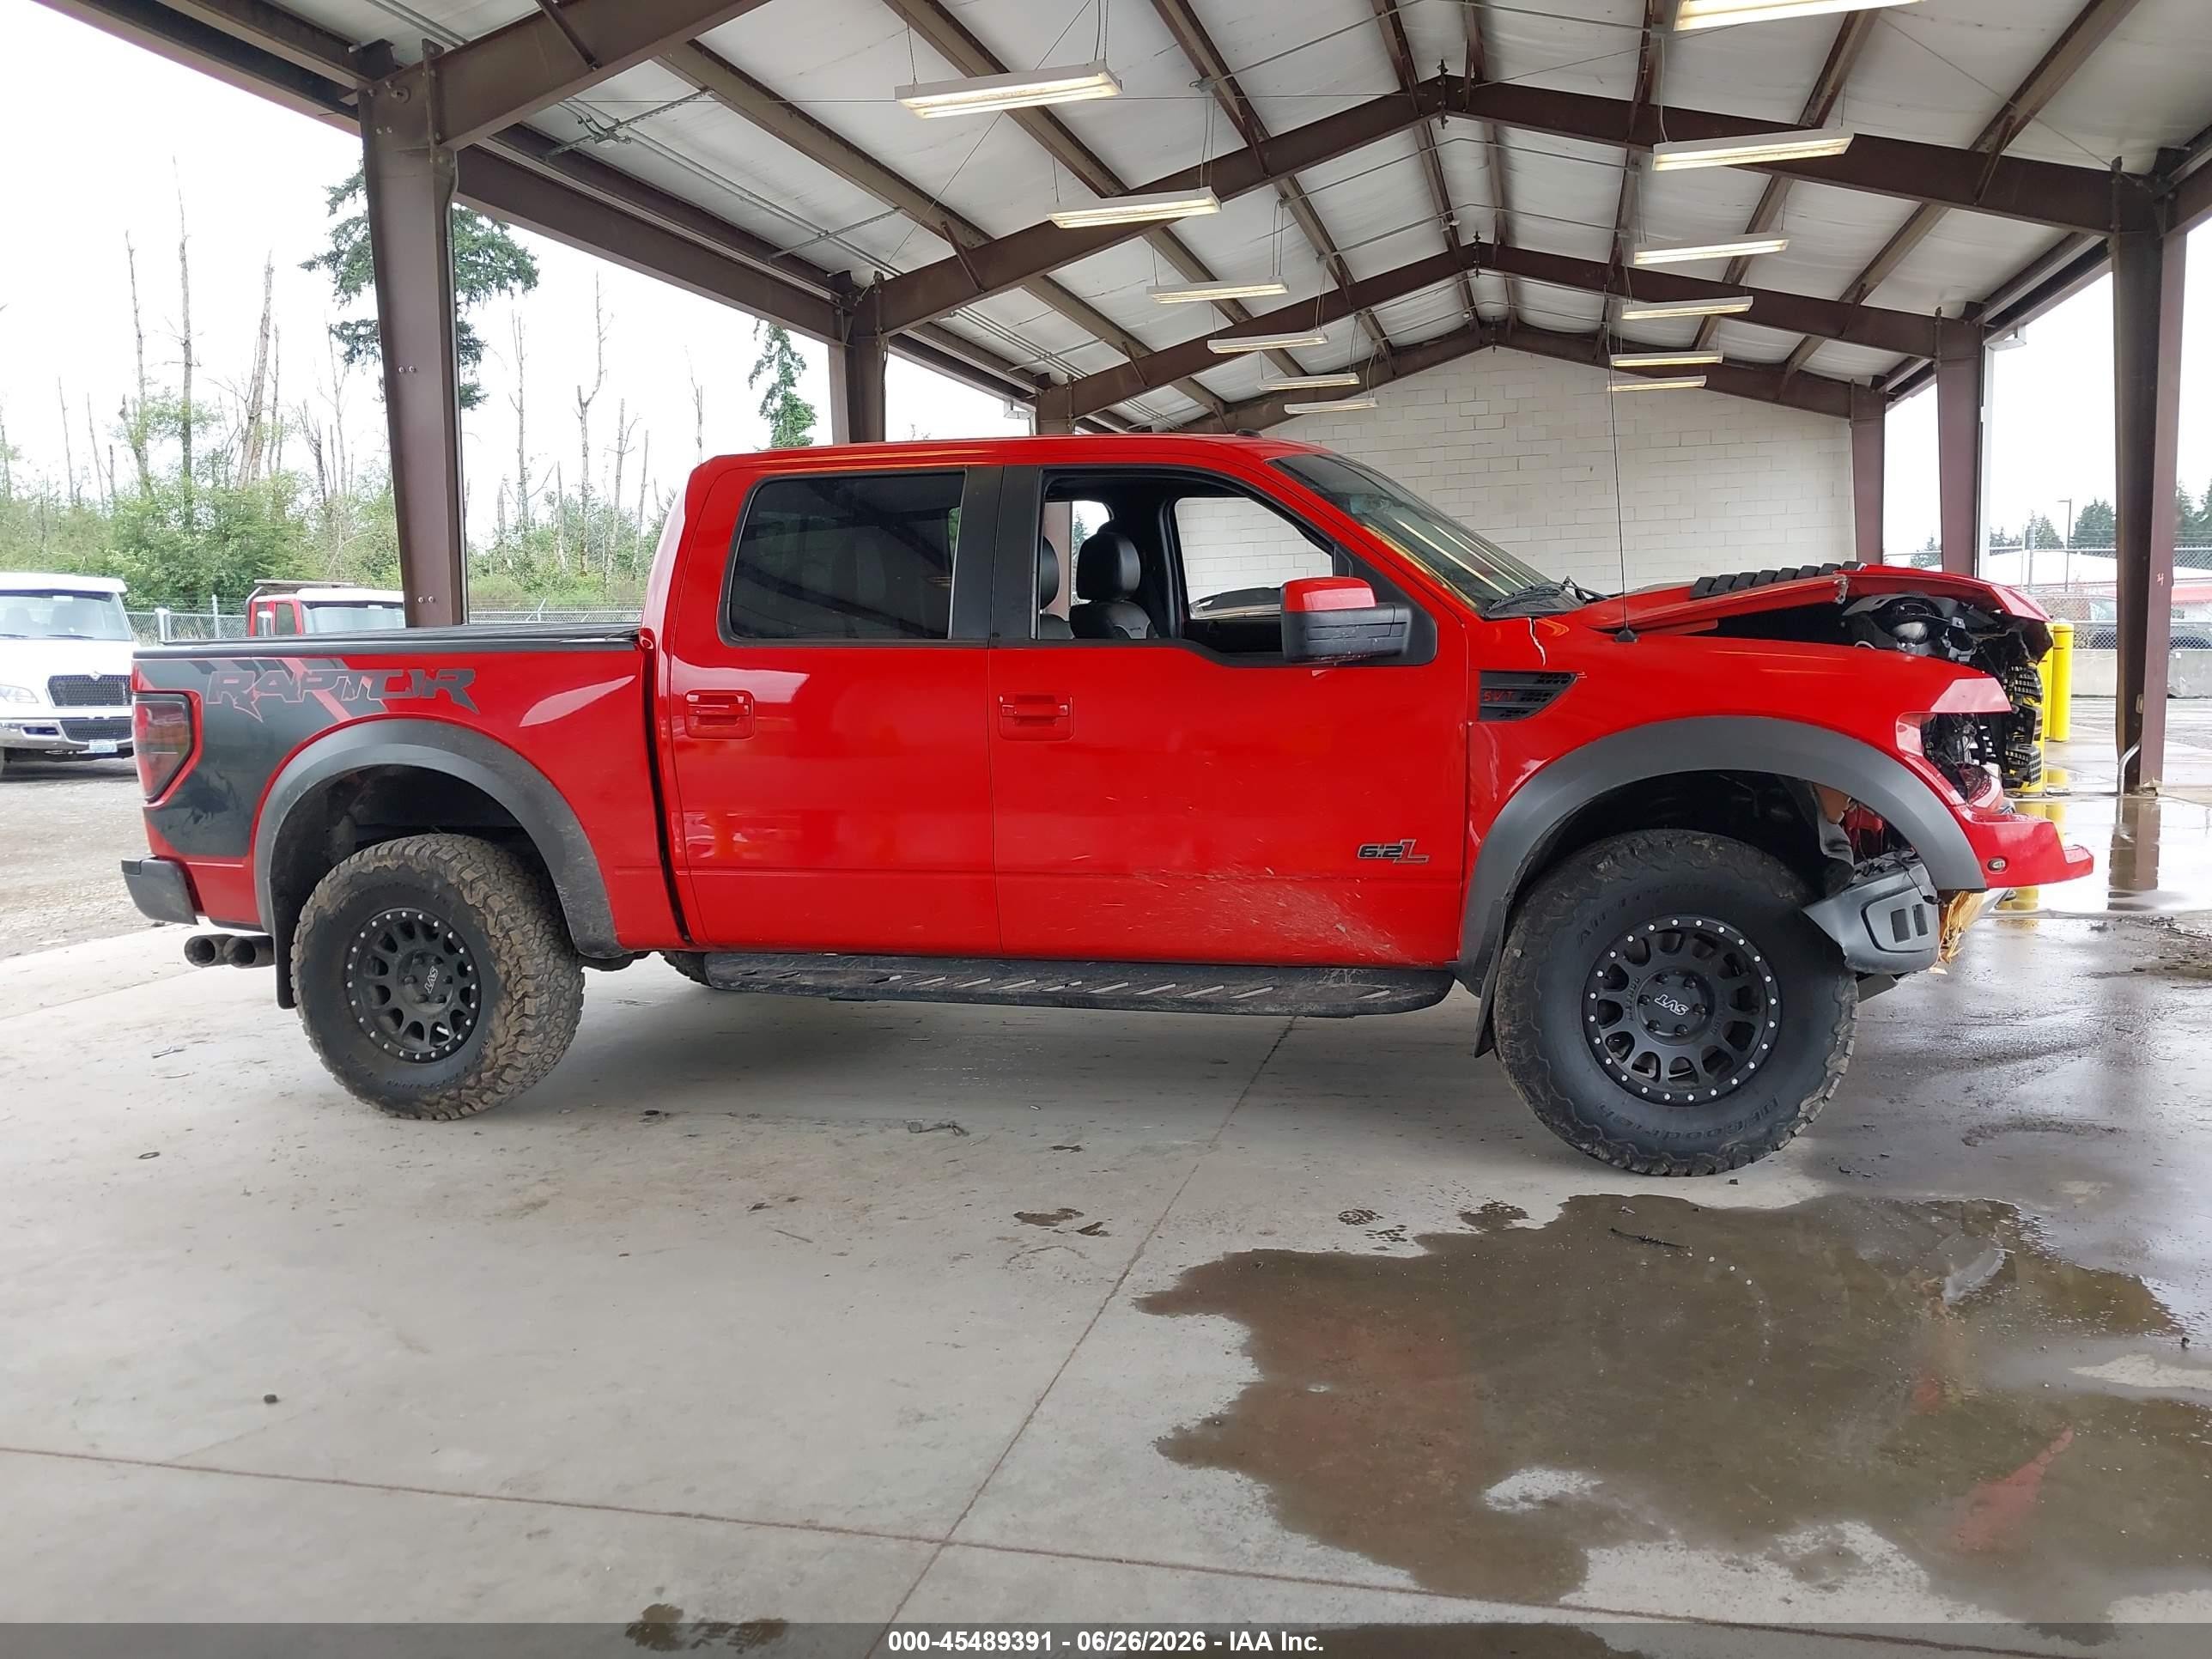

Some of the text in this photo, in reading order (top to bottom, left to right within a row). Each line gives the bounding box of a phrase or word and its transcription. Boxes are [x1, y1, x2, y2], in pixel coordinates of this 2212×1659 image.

[206, 669, 481, 723] RAPTOR
[1483, 690, 1516, 702] SVT
[424, 965, 438, 994] SVT
[1654, 994, 1690, 1016] SVT
